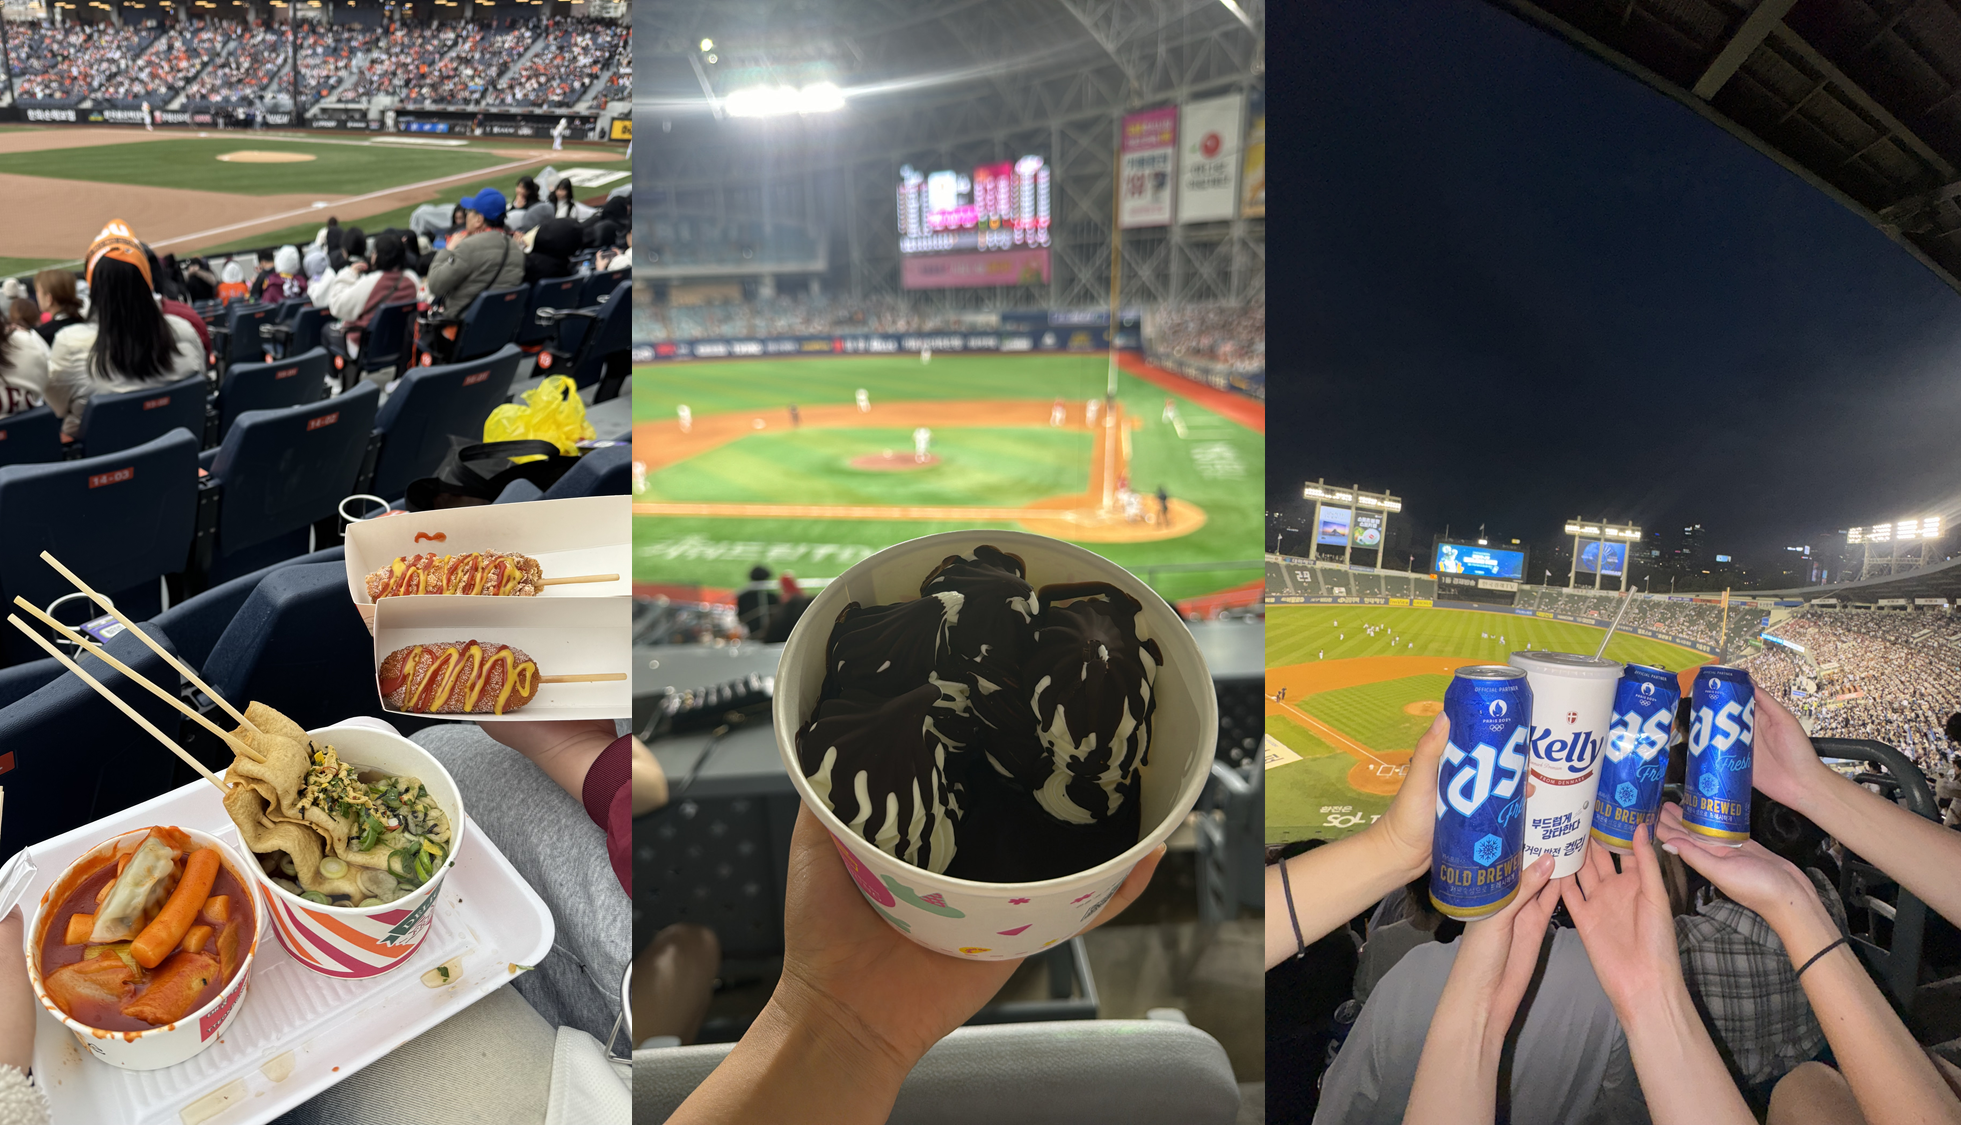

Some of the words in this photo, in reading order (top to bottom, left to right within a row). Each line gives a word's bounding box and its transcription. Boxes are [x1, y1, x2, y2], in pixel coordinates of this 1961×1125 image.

[93, 470, 130, 486] 14-03
[1530, 725, 1604, 773] Kelly
[1715, 752, 1751, 772] Fresh
[1539, 775, 1555, 784] FROM
[1557, 776, 1585, 785] DENMARK
[1320, 805, 1353, 813] 환전은
[1595, 800, 1613, 817] OLD
[1614, 806, 1656, 825] BREWED
[1700, 797, 1742, 816] BREWED
[1323, 812, 1366, 828] SOL
[1532, 812, 1573, 829] 부드럽게
[1541, 818, 1581, 840] 강타한다
[1523, 843, 1542, 857] 거의
[1563, 834, 1587, 857] 켈리
[1440, 864, 1472, 886] COLD
